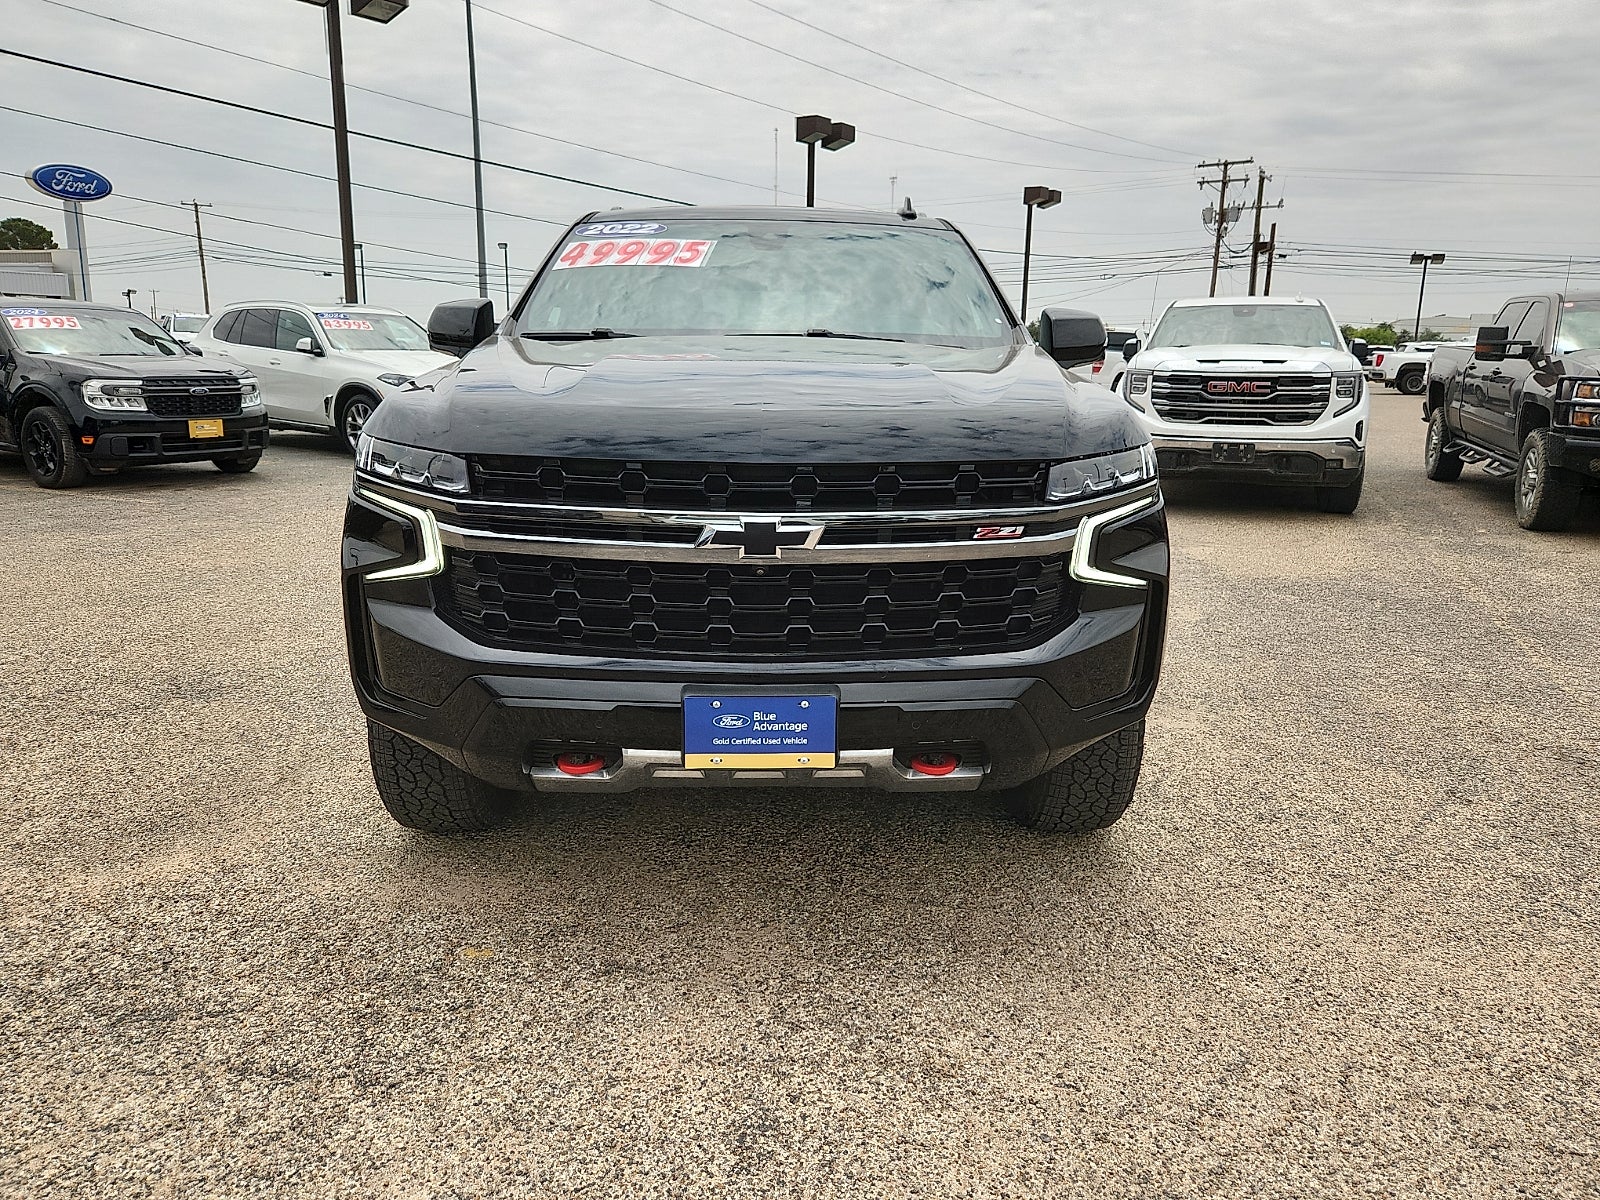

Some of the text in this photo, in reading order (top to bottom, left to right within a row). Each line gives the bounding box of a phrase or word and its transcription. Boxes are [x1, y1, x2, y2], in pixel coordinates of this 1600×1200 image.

[51, 170, 98, 194] Ford
[583, 222, 660, 235] 2022
[559, 240, 707, 267] 49995
[1207, 381, 1272, 393] GMC
[719, 716, 744, 726] Ford
[753, 711, 777, 721] Blue
[753, 721, 808, 732] Advantage
[712, 737, 808, 745] Gold Certified Used Vehicle
